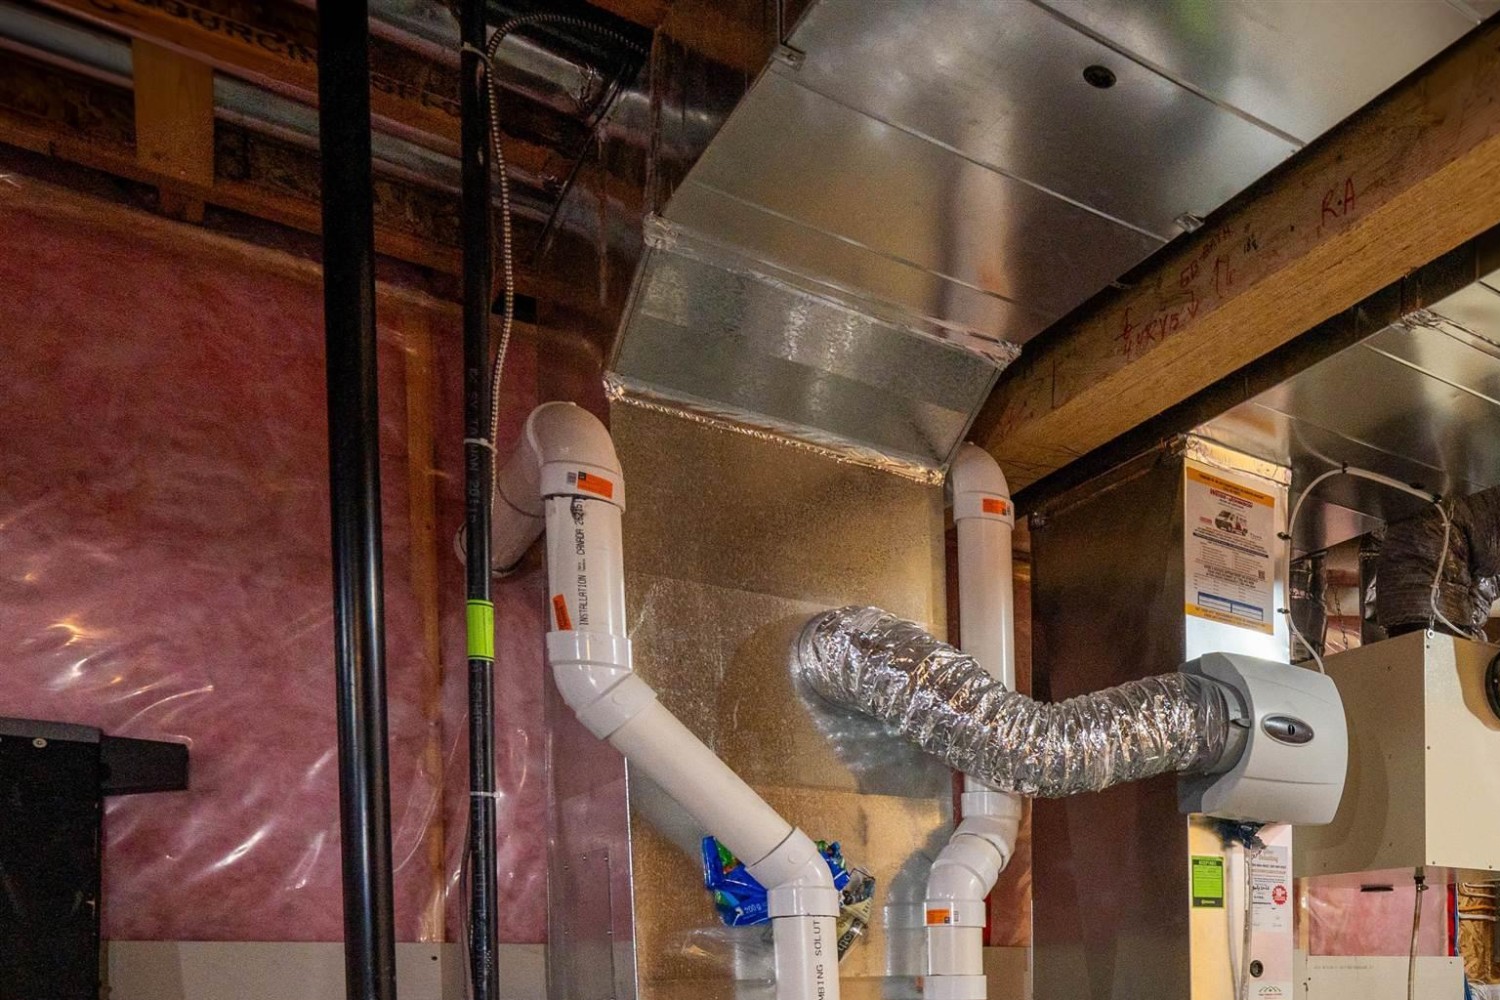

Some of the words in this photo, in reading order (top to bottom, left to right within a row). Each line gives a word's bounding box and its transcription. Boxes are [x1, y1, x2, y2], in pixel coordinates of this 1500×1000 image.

[575, 528, 586, 556] CANADA
[576, 574, 589, 626] INSTALLATION
[812, 920, 823, 957] SOLUT
